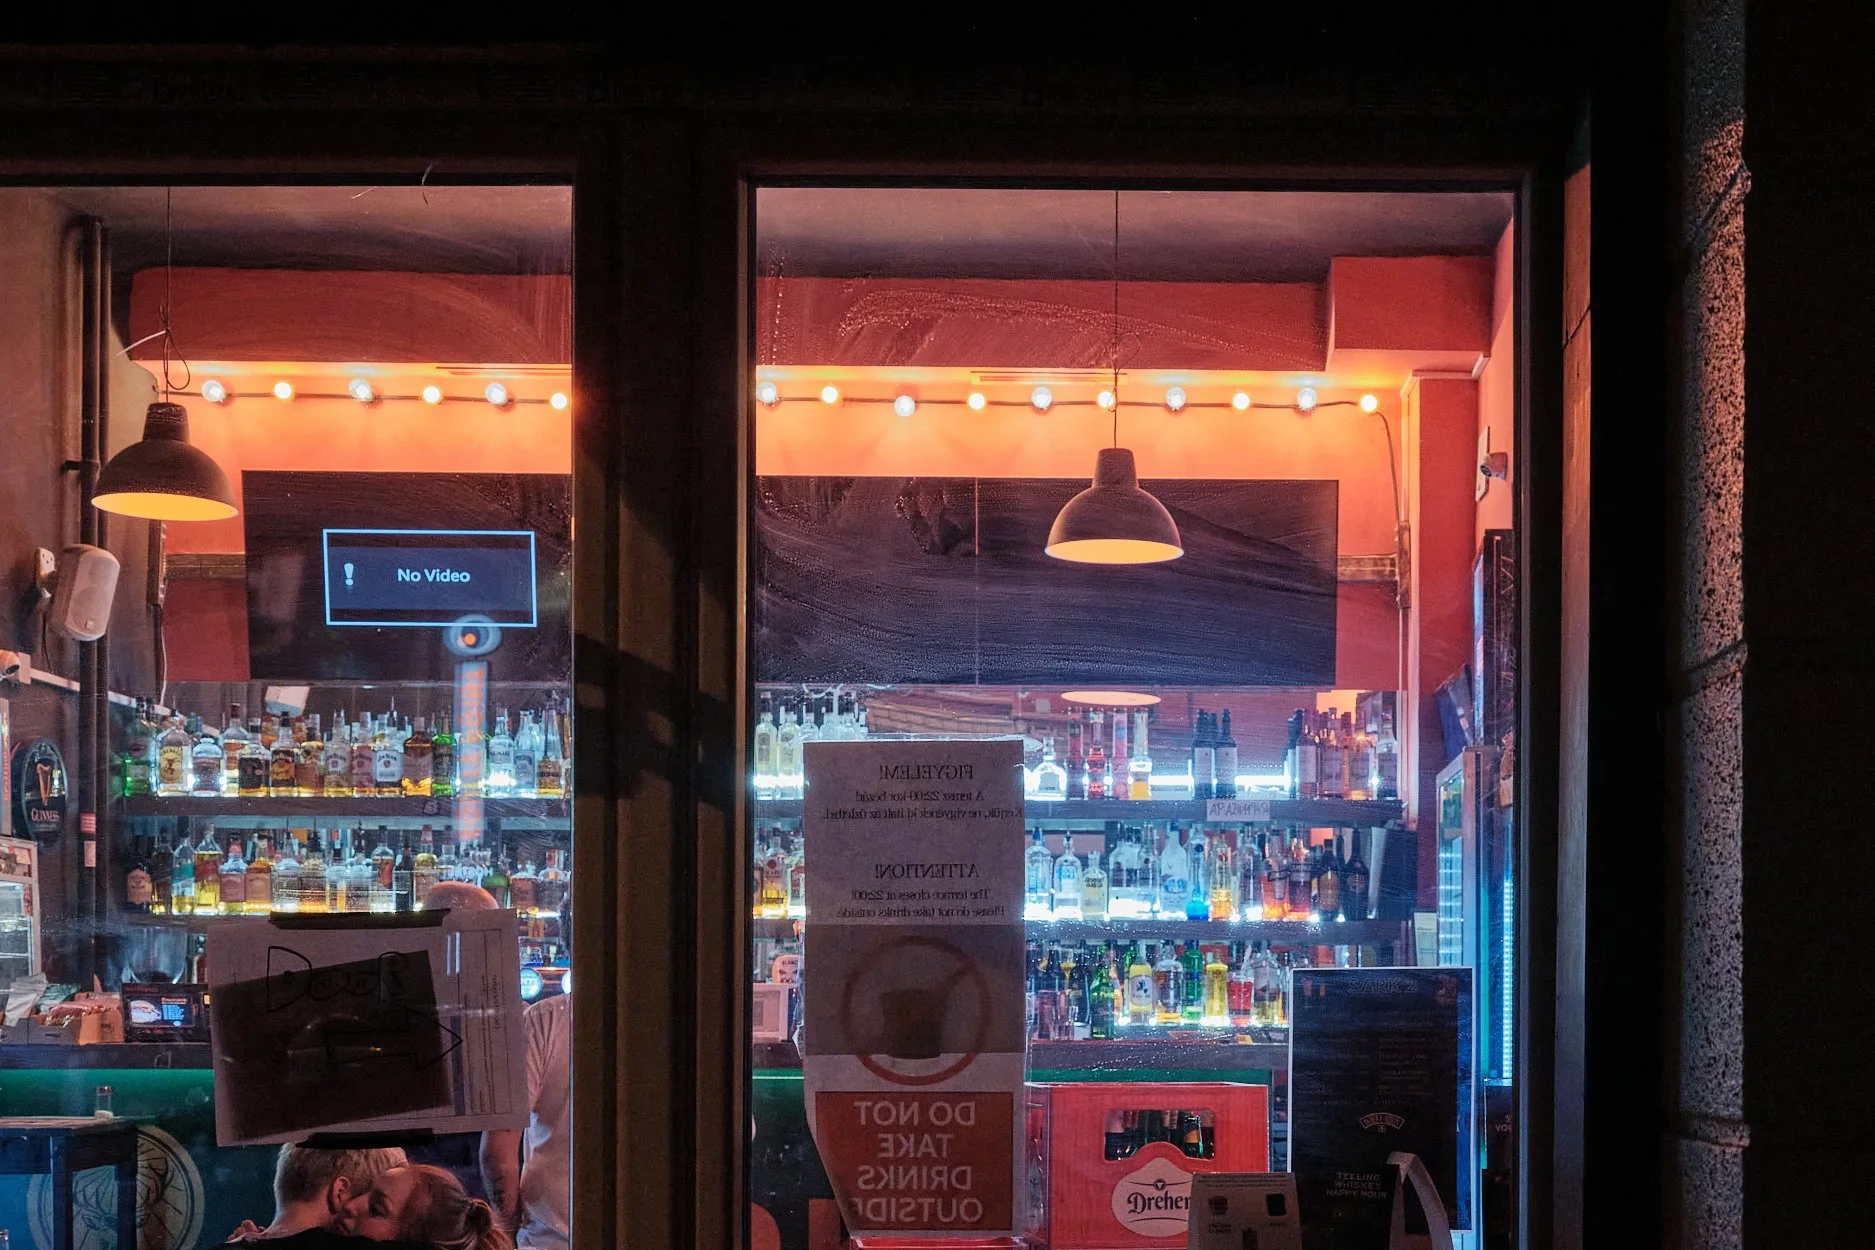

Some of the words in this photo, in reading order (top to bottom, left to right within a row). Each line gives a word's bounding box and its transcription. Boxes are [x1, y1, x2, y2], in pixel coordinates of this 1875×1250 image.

[397, 567, 421, 583] No
[424, 566, 471, 583] Video
[1336, 1172, 1381, 1181] TEELING
[1334, 1180, 1382, 1190] WHISKEY
[1325, 1188, 1358, 1197] HAPPY
[1360, 1189, 1388, 1199] HOUR
[1126, 1190, 1191, 1215] Dreher
